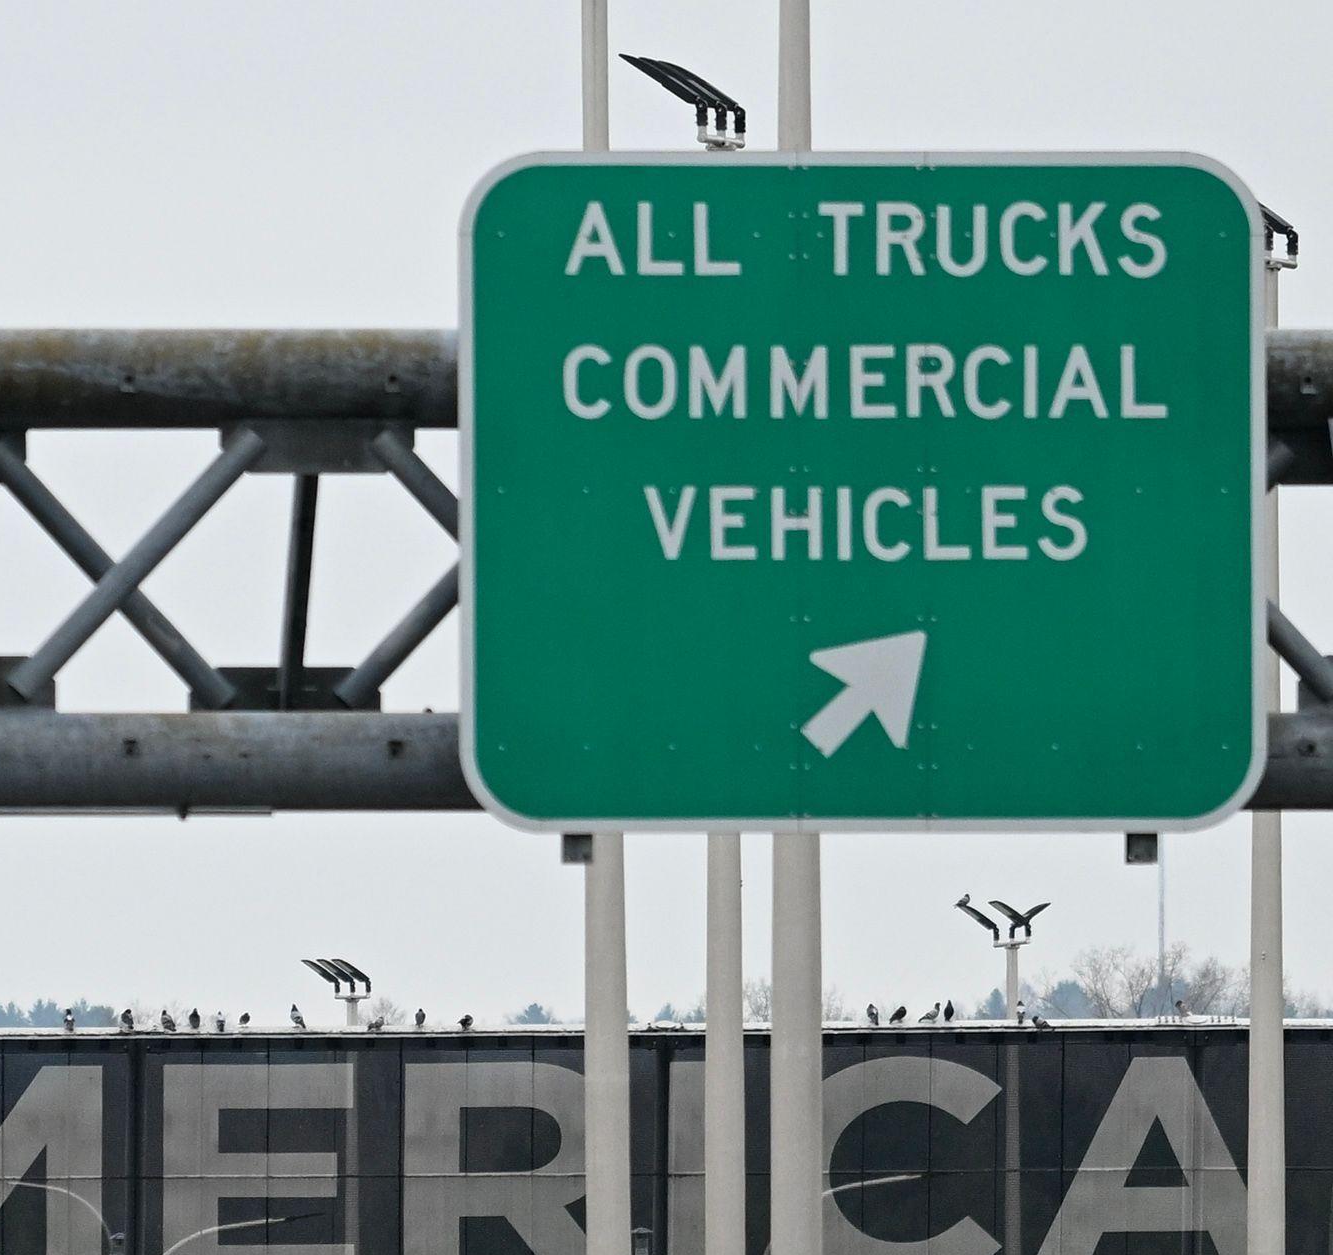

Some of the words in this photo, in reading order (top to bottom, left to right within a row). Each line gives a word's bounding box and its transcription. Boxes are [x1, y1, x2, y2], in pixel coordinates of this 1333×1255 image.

[565, 202, 741, 276] ALL
[819, 202, 1168, 279] TRUCKS
[562, 345, 1169, 420] COMMERCIAL
[644, 486, 1088, 561] VEHICLES
